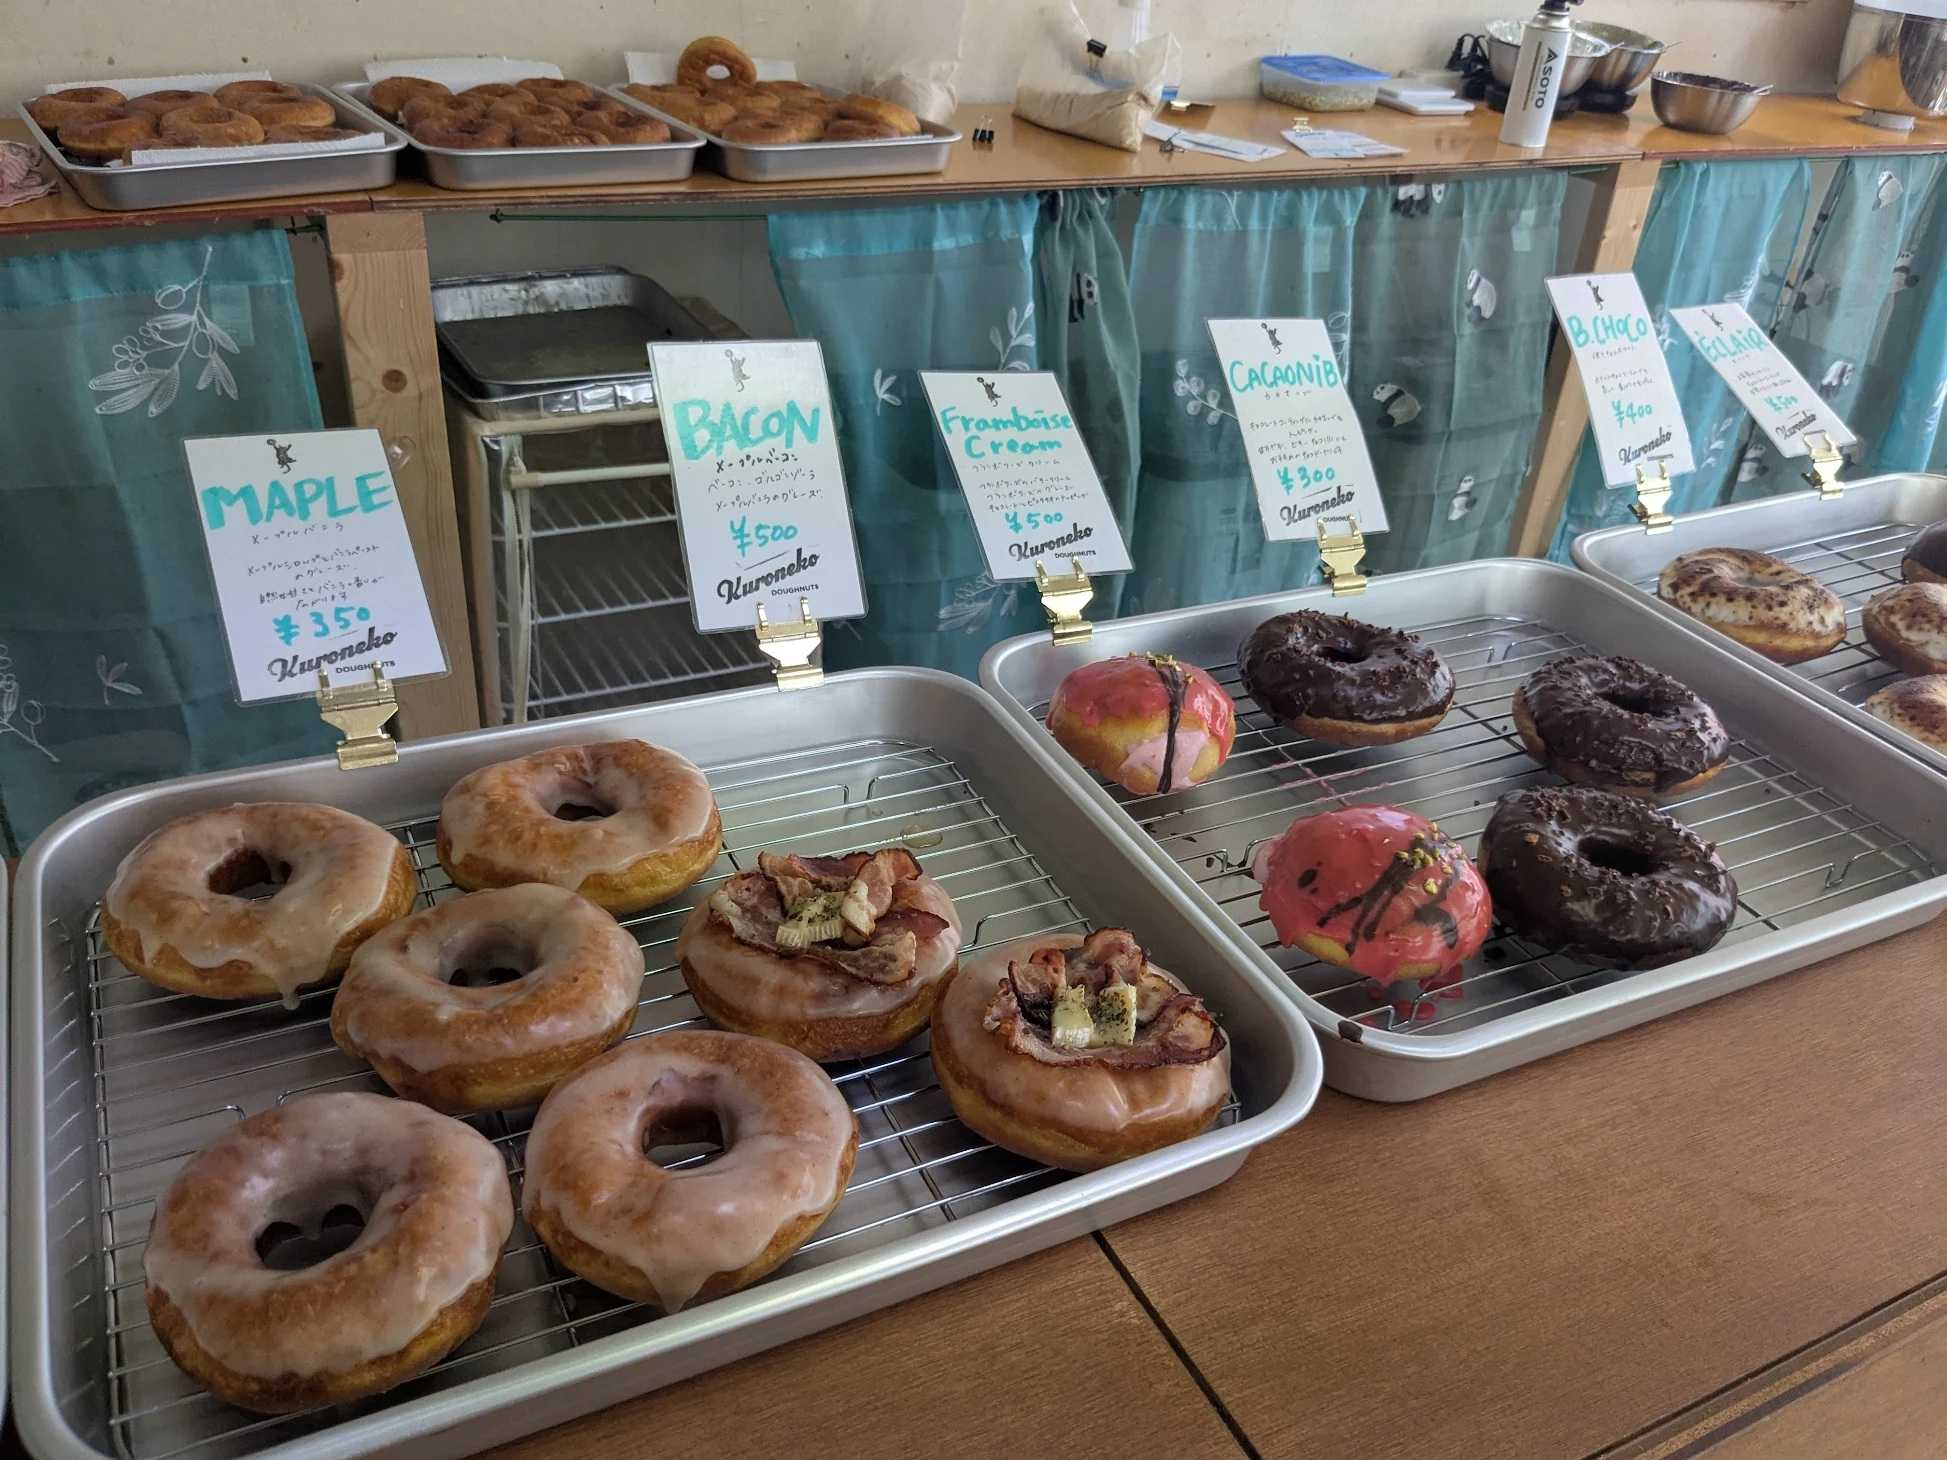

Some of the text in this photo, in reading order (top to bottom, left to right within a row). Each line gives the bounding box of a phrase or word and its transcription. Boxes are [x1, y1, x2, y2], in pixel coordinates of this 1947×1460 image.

[672, 399, 821, 461] BACON
[940, 406, 1073, 434] Framboise
[964, 435, 1062, 459] Cream
[1619, 427, 1672, 465] Kuroneko
[201, 470, 394, 530] MAPLE
[1276, 466, 1336, 496] ¥300
[1005, 511, 1063, 535] ¥500
[1280, 485, 1355, 526] Kuroneko
[730, 516, 798, 558] ¥500
[1008, 522, 1094, 562] Kuroneko
[717, 548, 820, 605] Kuroneko
[771, 583, 820, 597] DOUGHNUTS
[272, 606, 371, 647] ¥350
[267, 626, 398, 682] Kuroneko
